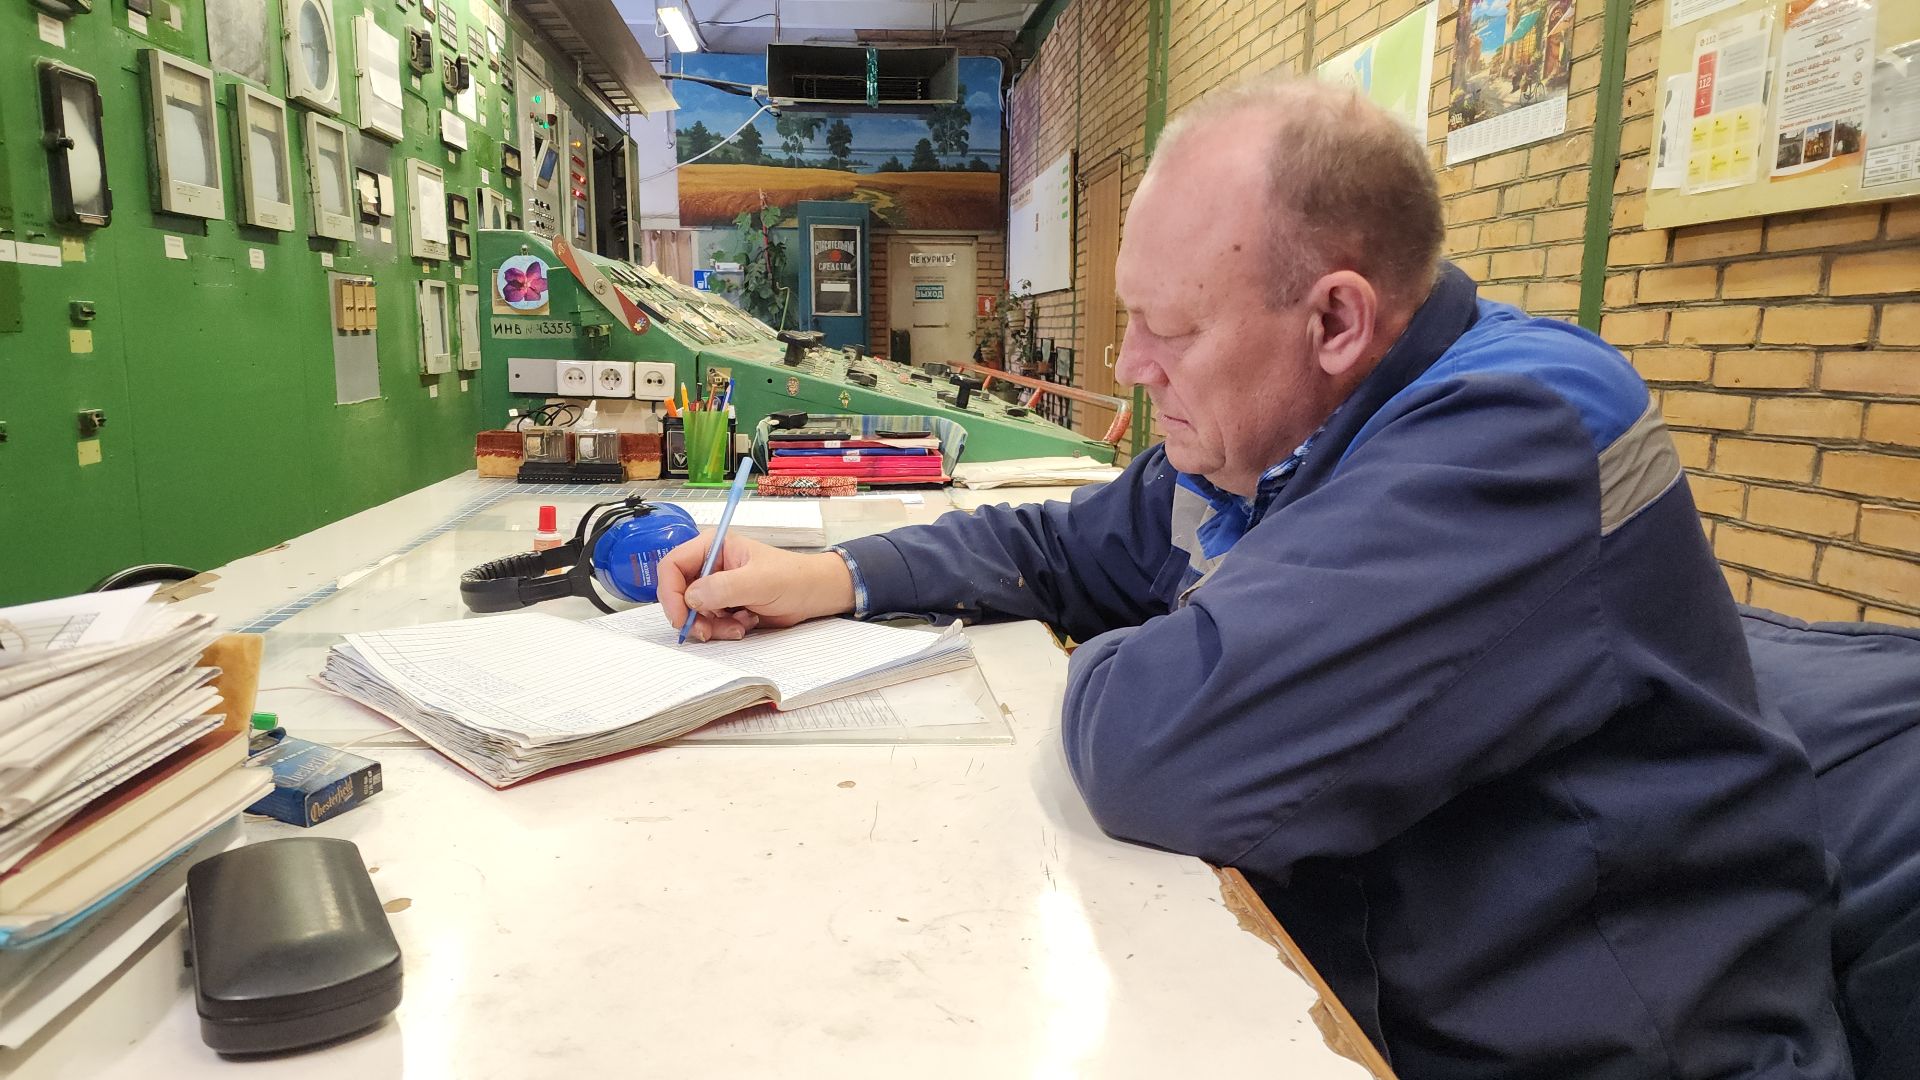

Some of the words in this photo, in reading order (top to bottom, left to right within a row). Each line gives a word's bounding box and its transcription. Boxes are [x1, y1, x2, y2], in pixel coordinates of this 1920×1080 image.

[1698, 77, 1712, 89] 112
[910, 255, 920, 264] НЕ
[818, 262, 852, 271] СРЕДСТВА
[915, 290, 943, 299] ВЫХОД
[493, 322, 522, 335] ИНВ
[536, 321, 572, 335] 43355
[310, 775, 354, 823] Chesterfield
